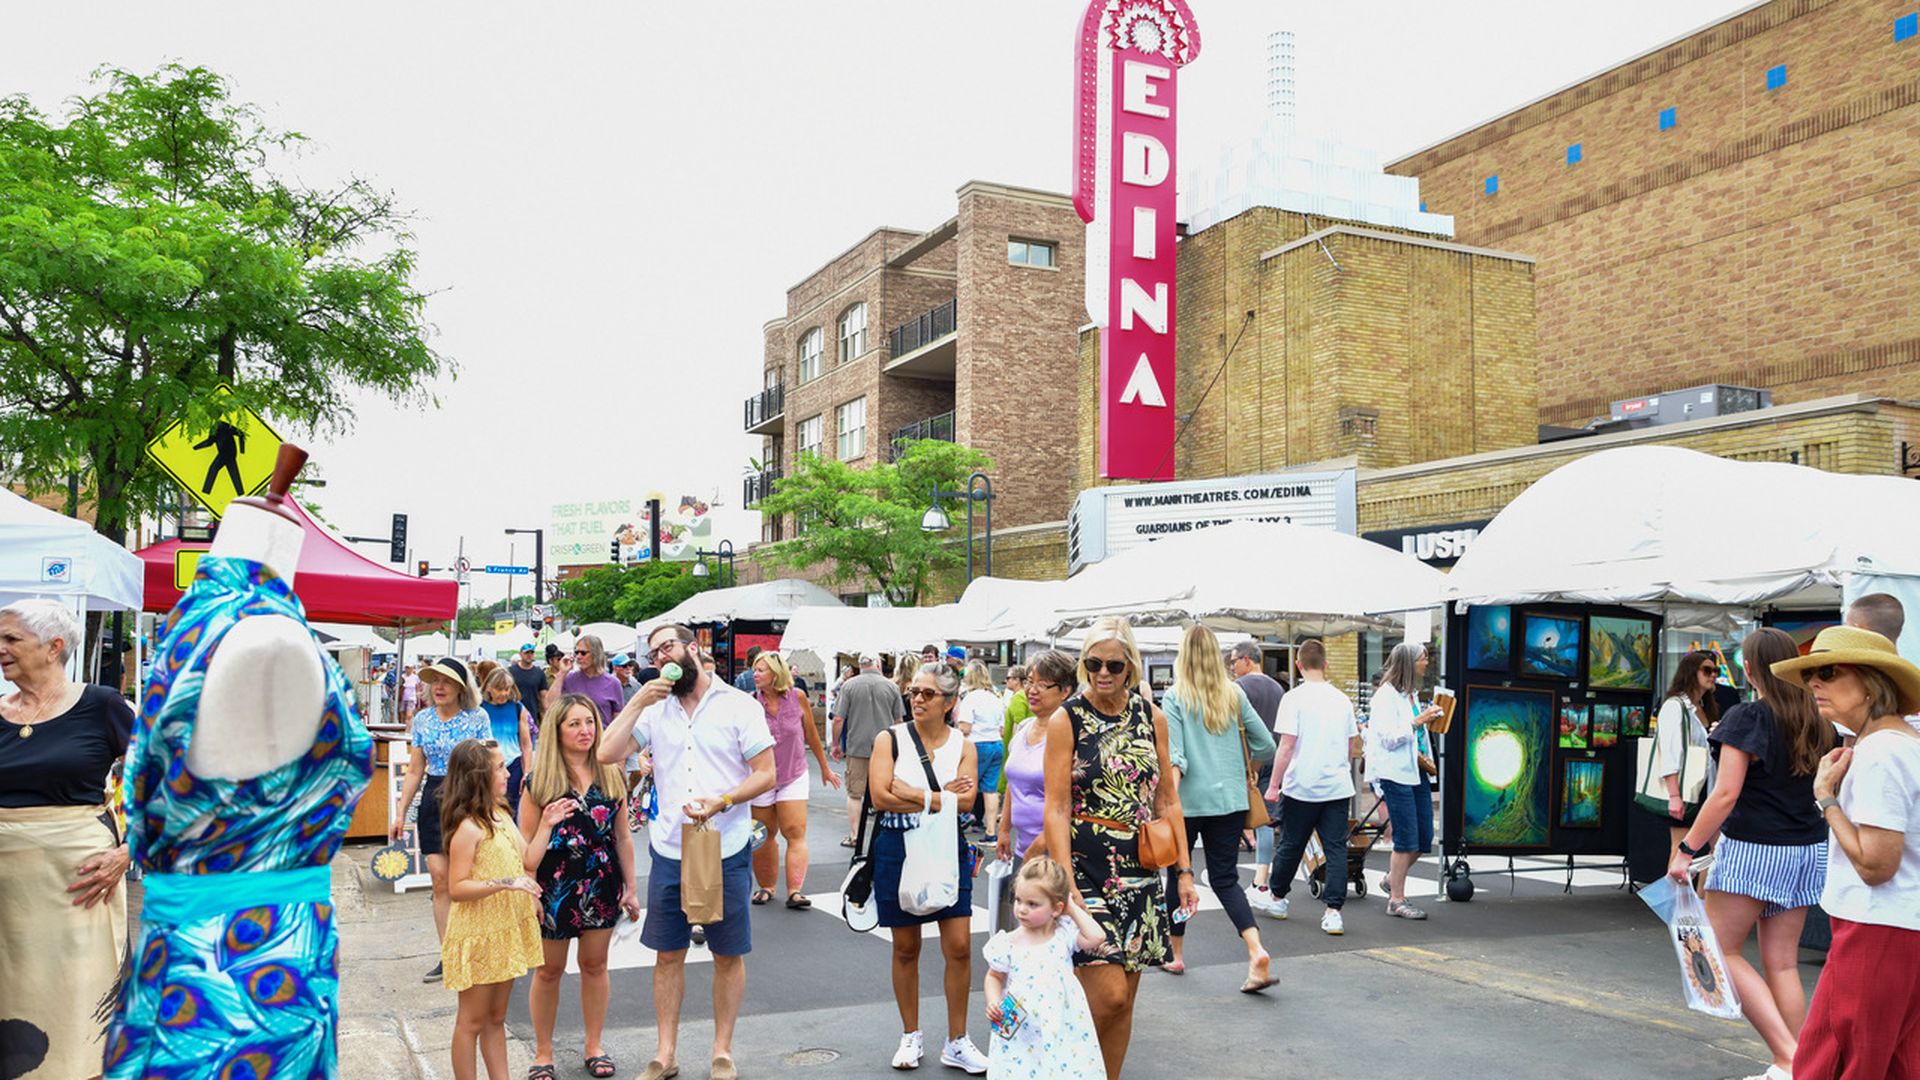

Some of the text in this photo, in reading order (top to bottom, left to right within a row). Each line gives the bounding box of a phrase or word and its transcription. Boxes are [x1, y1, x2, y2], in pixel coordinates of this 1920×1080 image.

[1119, 60, 1170, 407] EDINA
[552, 500, 630, 518] FRESH FLAVORS
[552, 521, 606, 536] THAT FUEL
[1136, 522, 1192, 534] GUARDIANS
